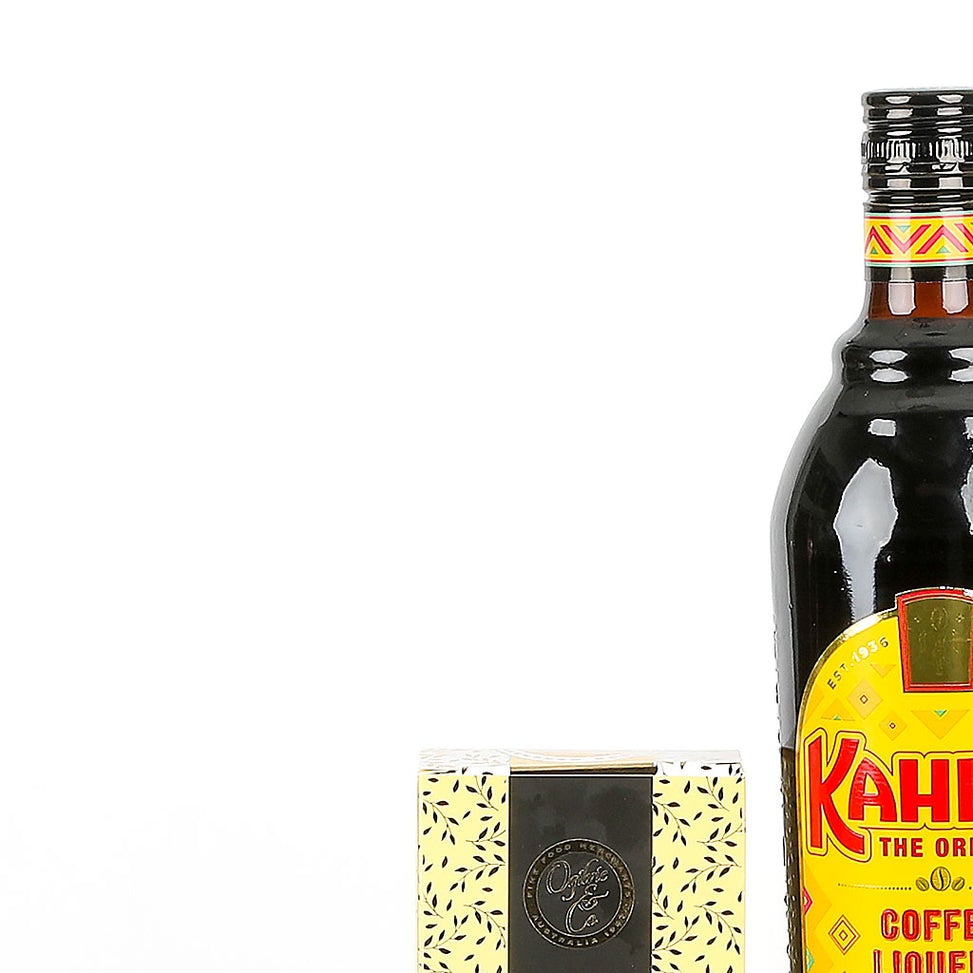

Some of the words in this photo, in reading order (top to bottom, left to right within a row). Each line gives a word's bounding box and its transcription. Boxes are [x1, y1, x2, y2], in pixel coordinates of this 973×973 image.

[852, 637, 888, 663] 1936
[541, 844, 572, 864] FOOD
[879, 837, 923, 857] THE
[532, 914, 598, 946] AUSTRALIA
